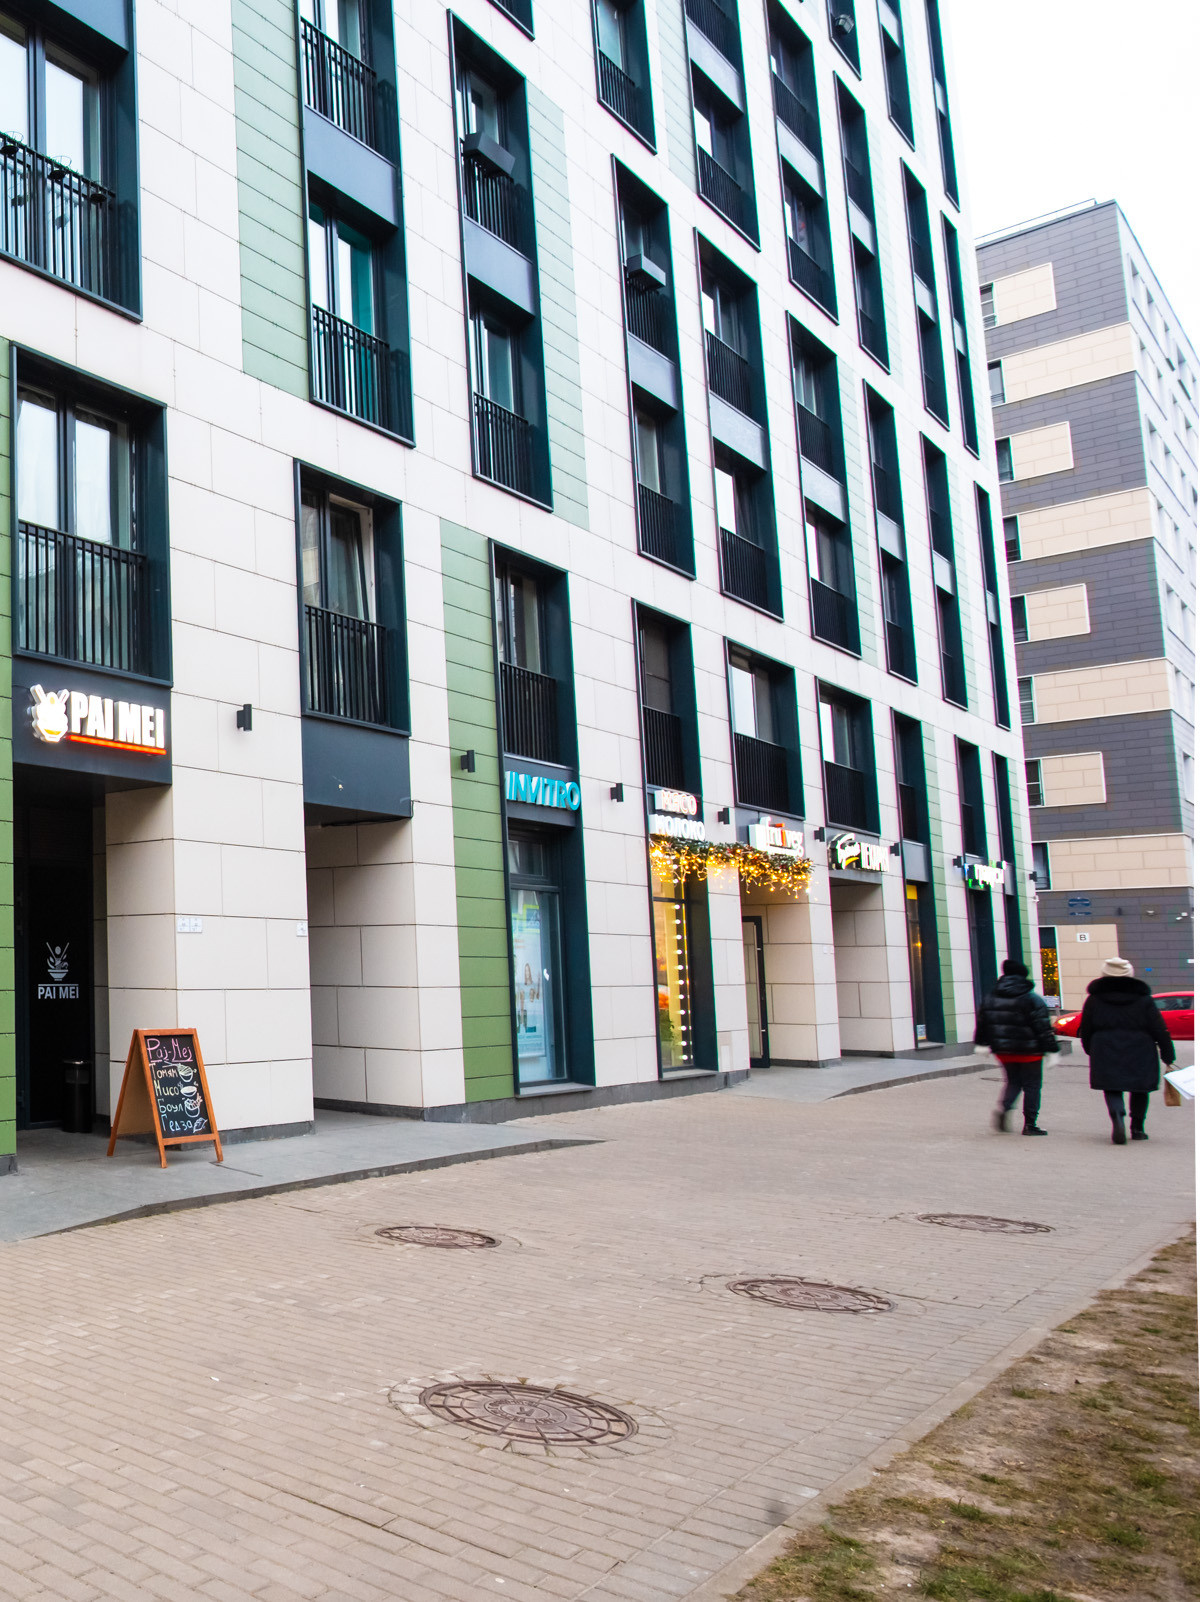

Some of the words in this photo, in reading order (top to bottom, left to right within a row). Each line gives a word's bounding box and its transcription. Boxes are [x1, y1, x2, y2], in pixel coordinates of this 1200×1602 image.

[70, 691, 114, 739] PAI
[114, 701, 166, 749] MEI
[505, 771, 581, 811] INVITRO
[38, 986, 56, 999] PAI
[59, 986, 79, 999] MEI
[154, 1080, 180, 1096] Мисо
[158, 1098, 184, 1114] Боул
